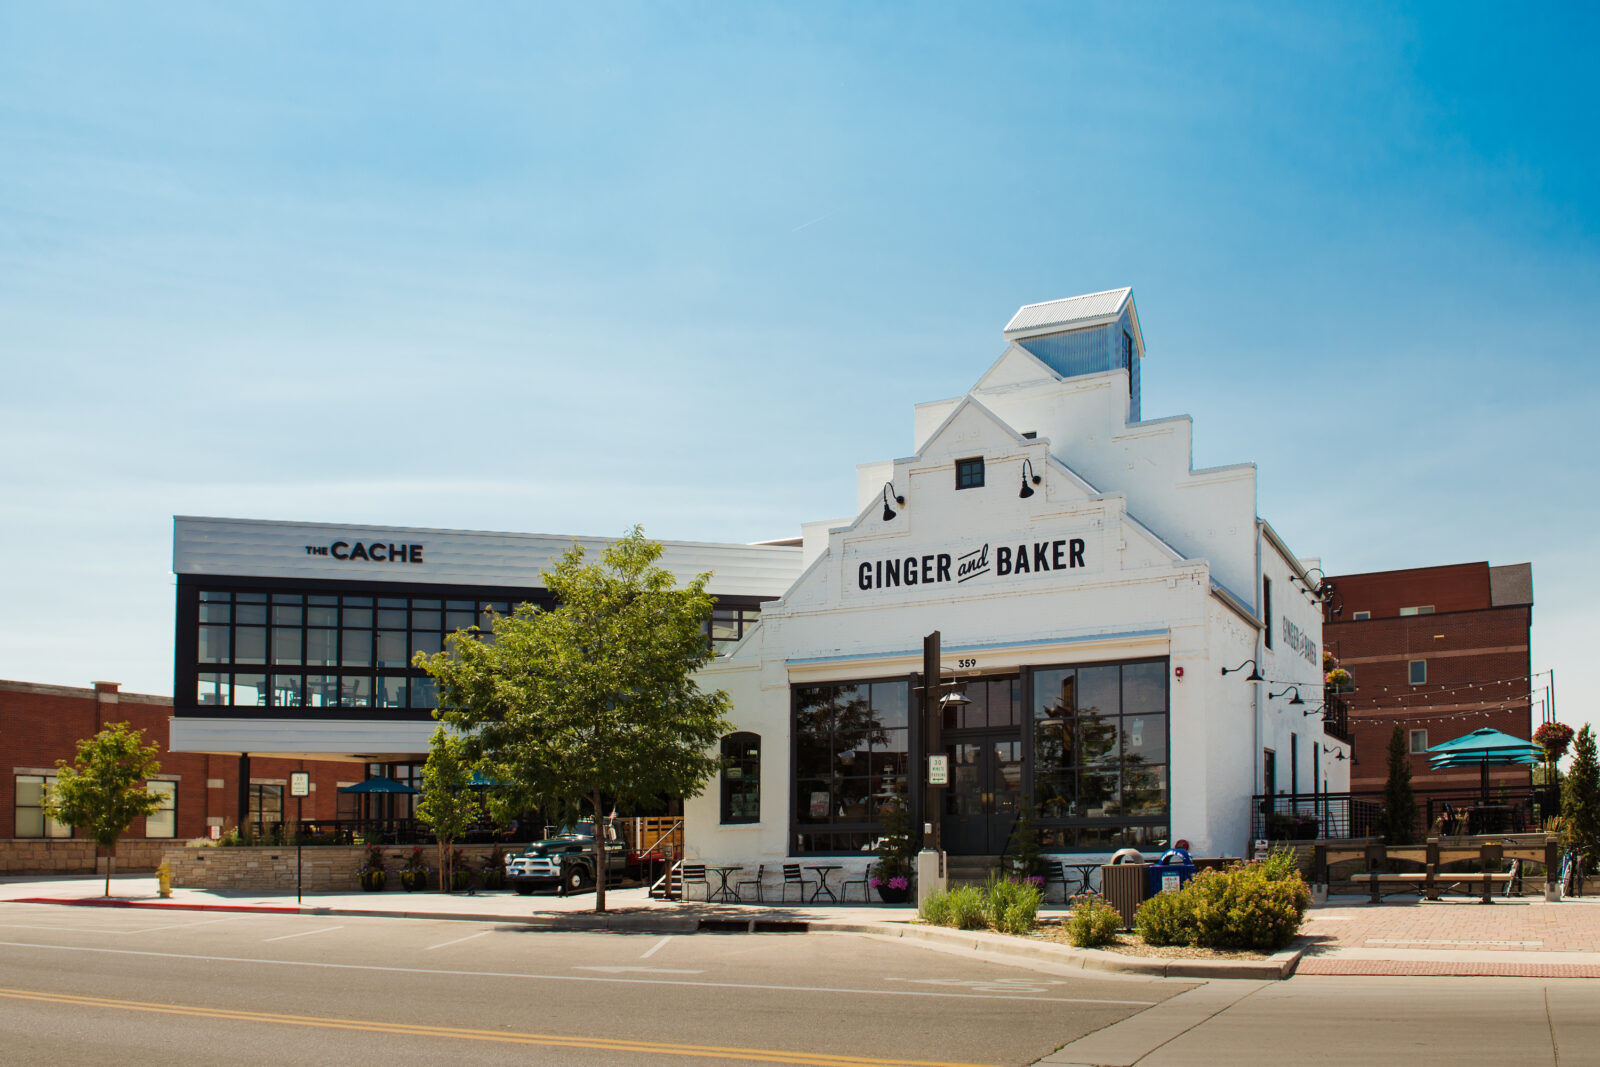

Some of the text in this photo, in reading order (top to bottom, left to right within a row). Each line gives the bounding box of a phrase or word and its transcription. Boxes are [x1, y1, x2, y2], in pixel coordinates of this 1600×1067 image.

[305, 541, 423, 563] THE CACHE
[858, 538, 1085, 590] GINGER and BAKER
[958, 658, 977, 668] 359
